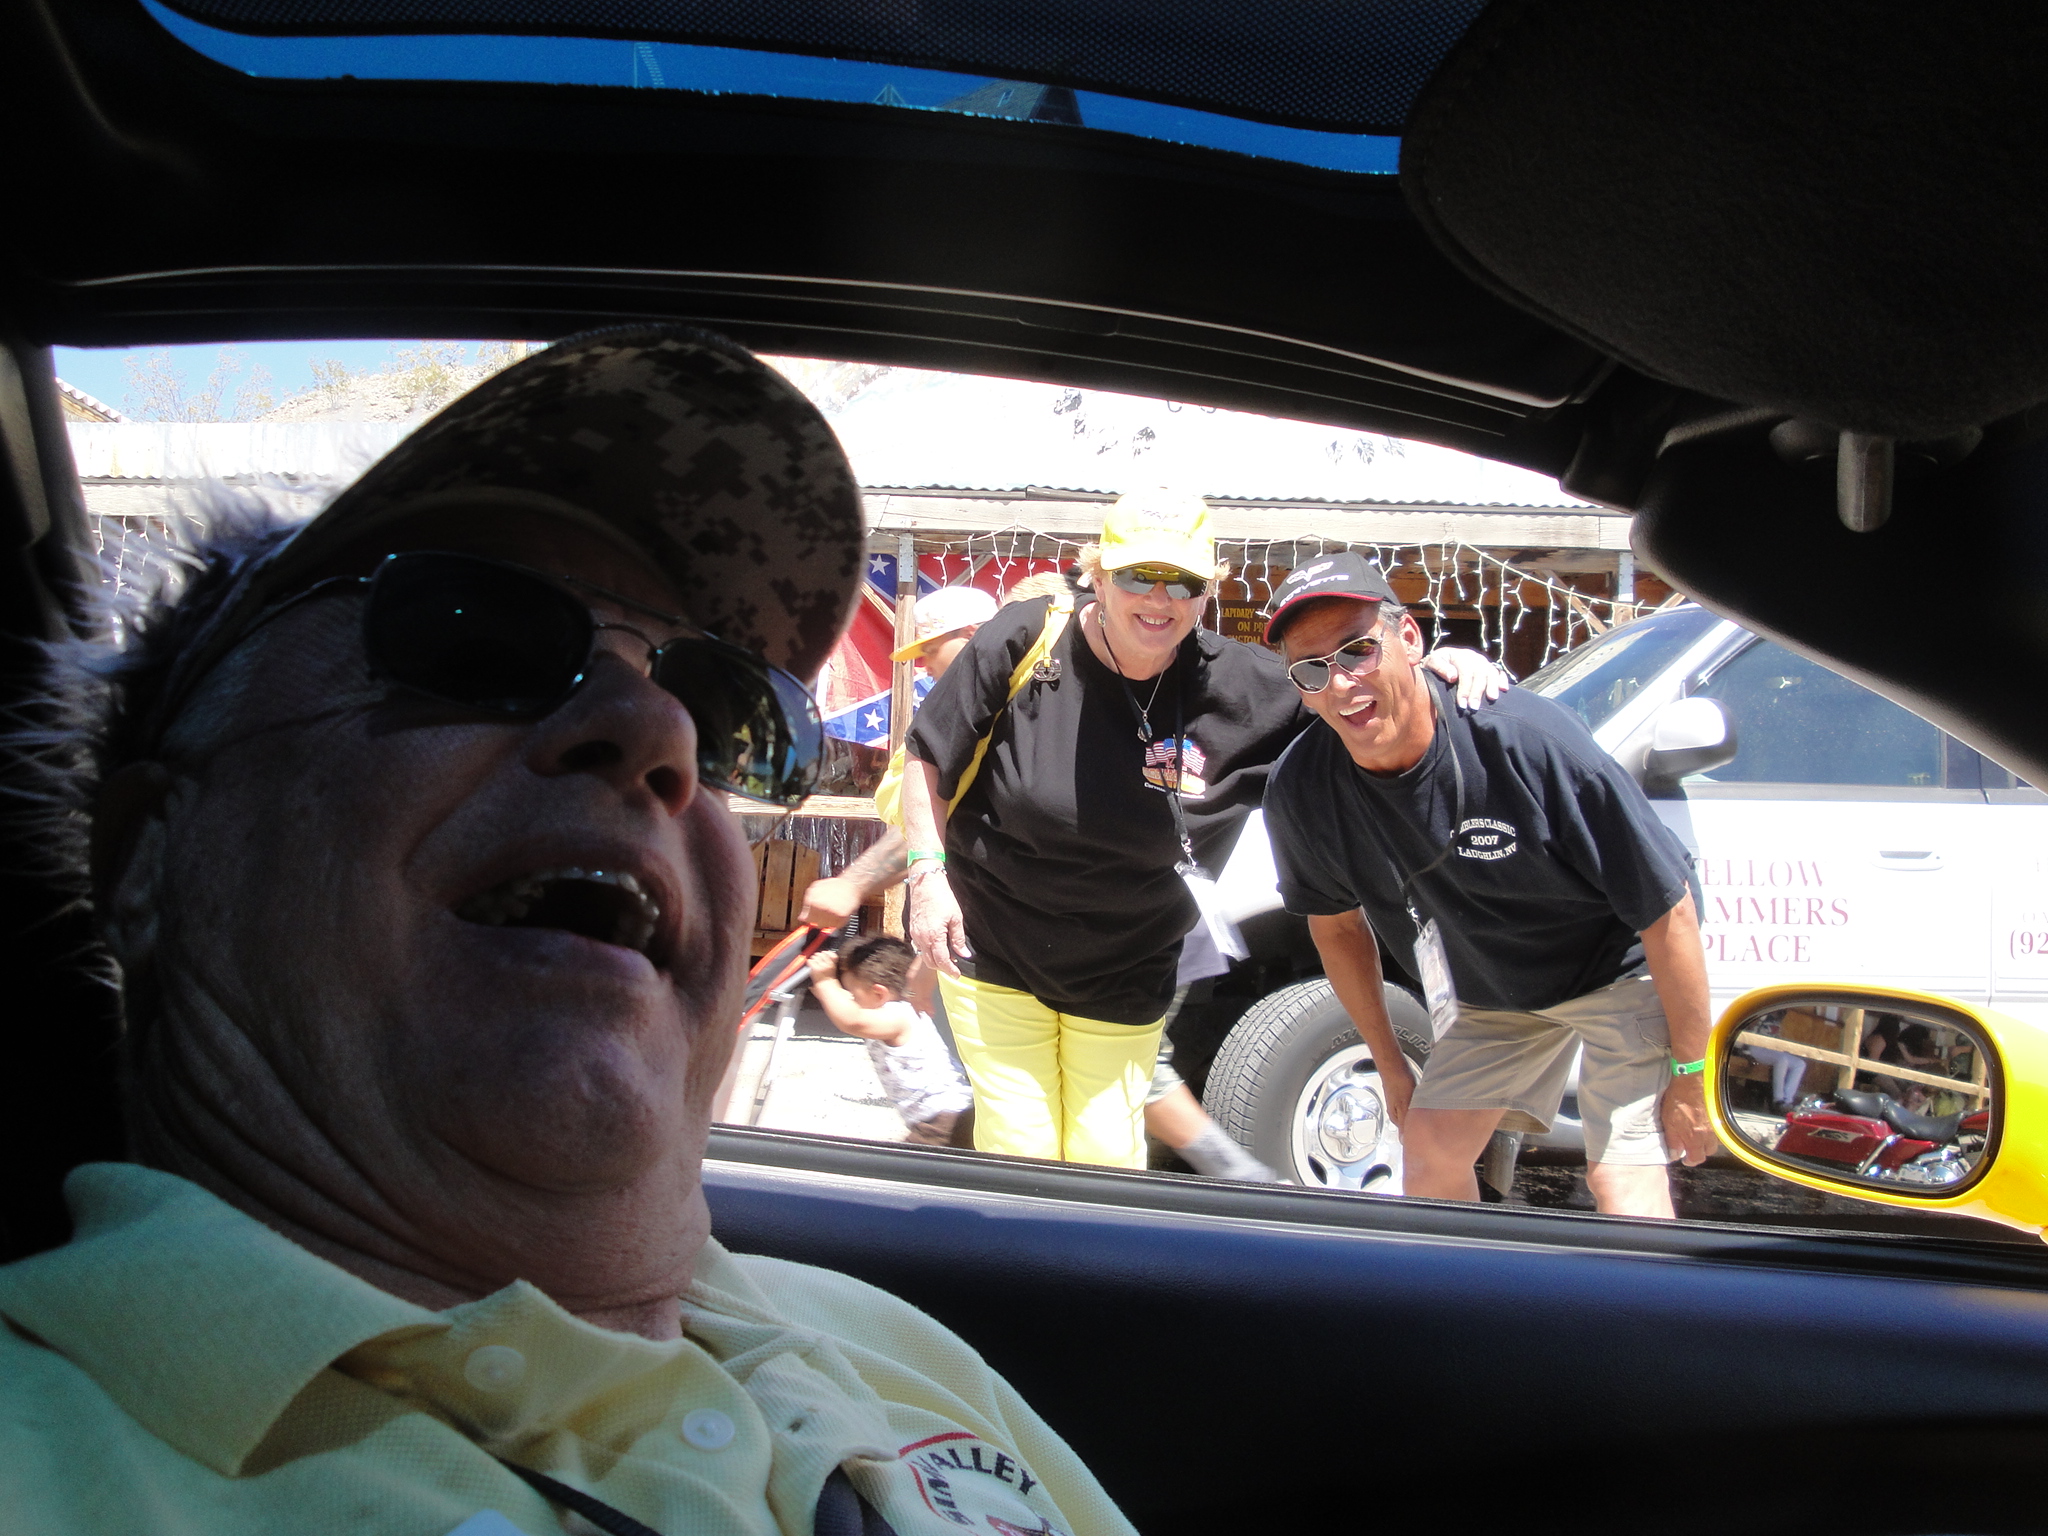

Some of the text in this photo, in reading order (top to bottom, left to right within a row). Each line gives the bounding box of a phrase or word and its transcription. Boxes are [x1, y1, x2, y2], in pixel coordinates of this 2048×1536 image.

[1221, 607, 1255, 618] LAPIDARY
[1237, 621, 1250, 631] ON
[1484, 818, 1516, 837] CLASSIC
[1471, 835, 1499, 845] 2007
[1504, 842, 1517, 856] NV
[1701, 858, 1827, 888] ELLOW
